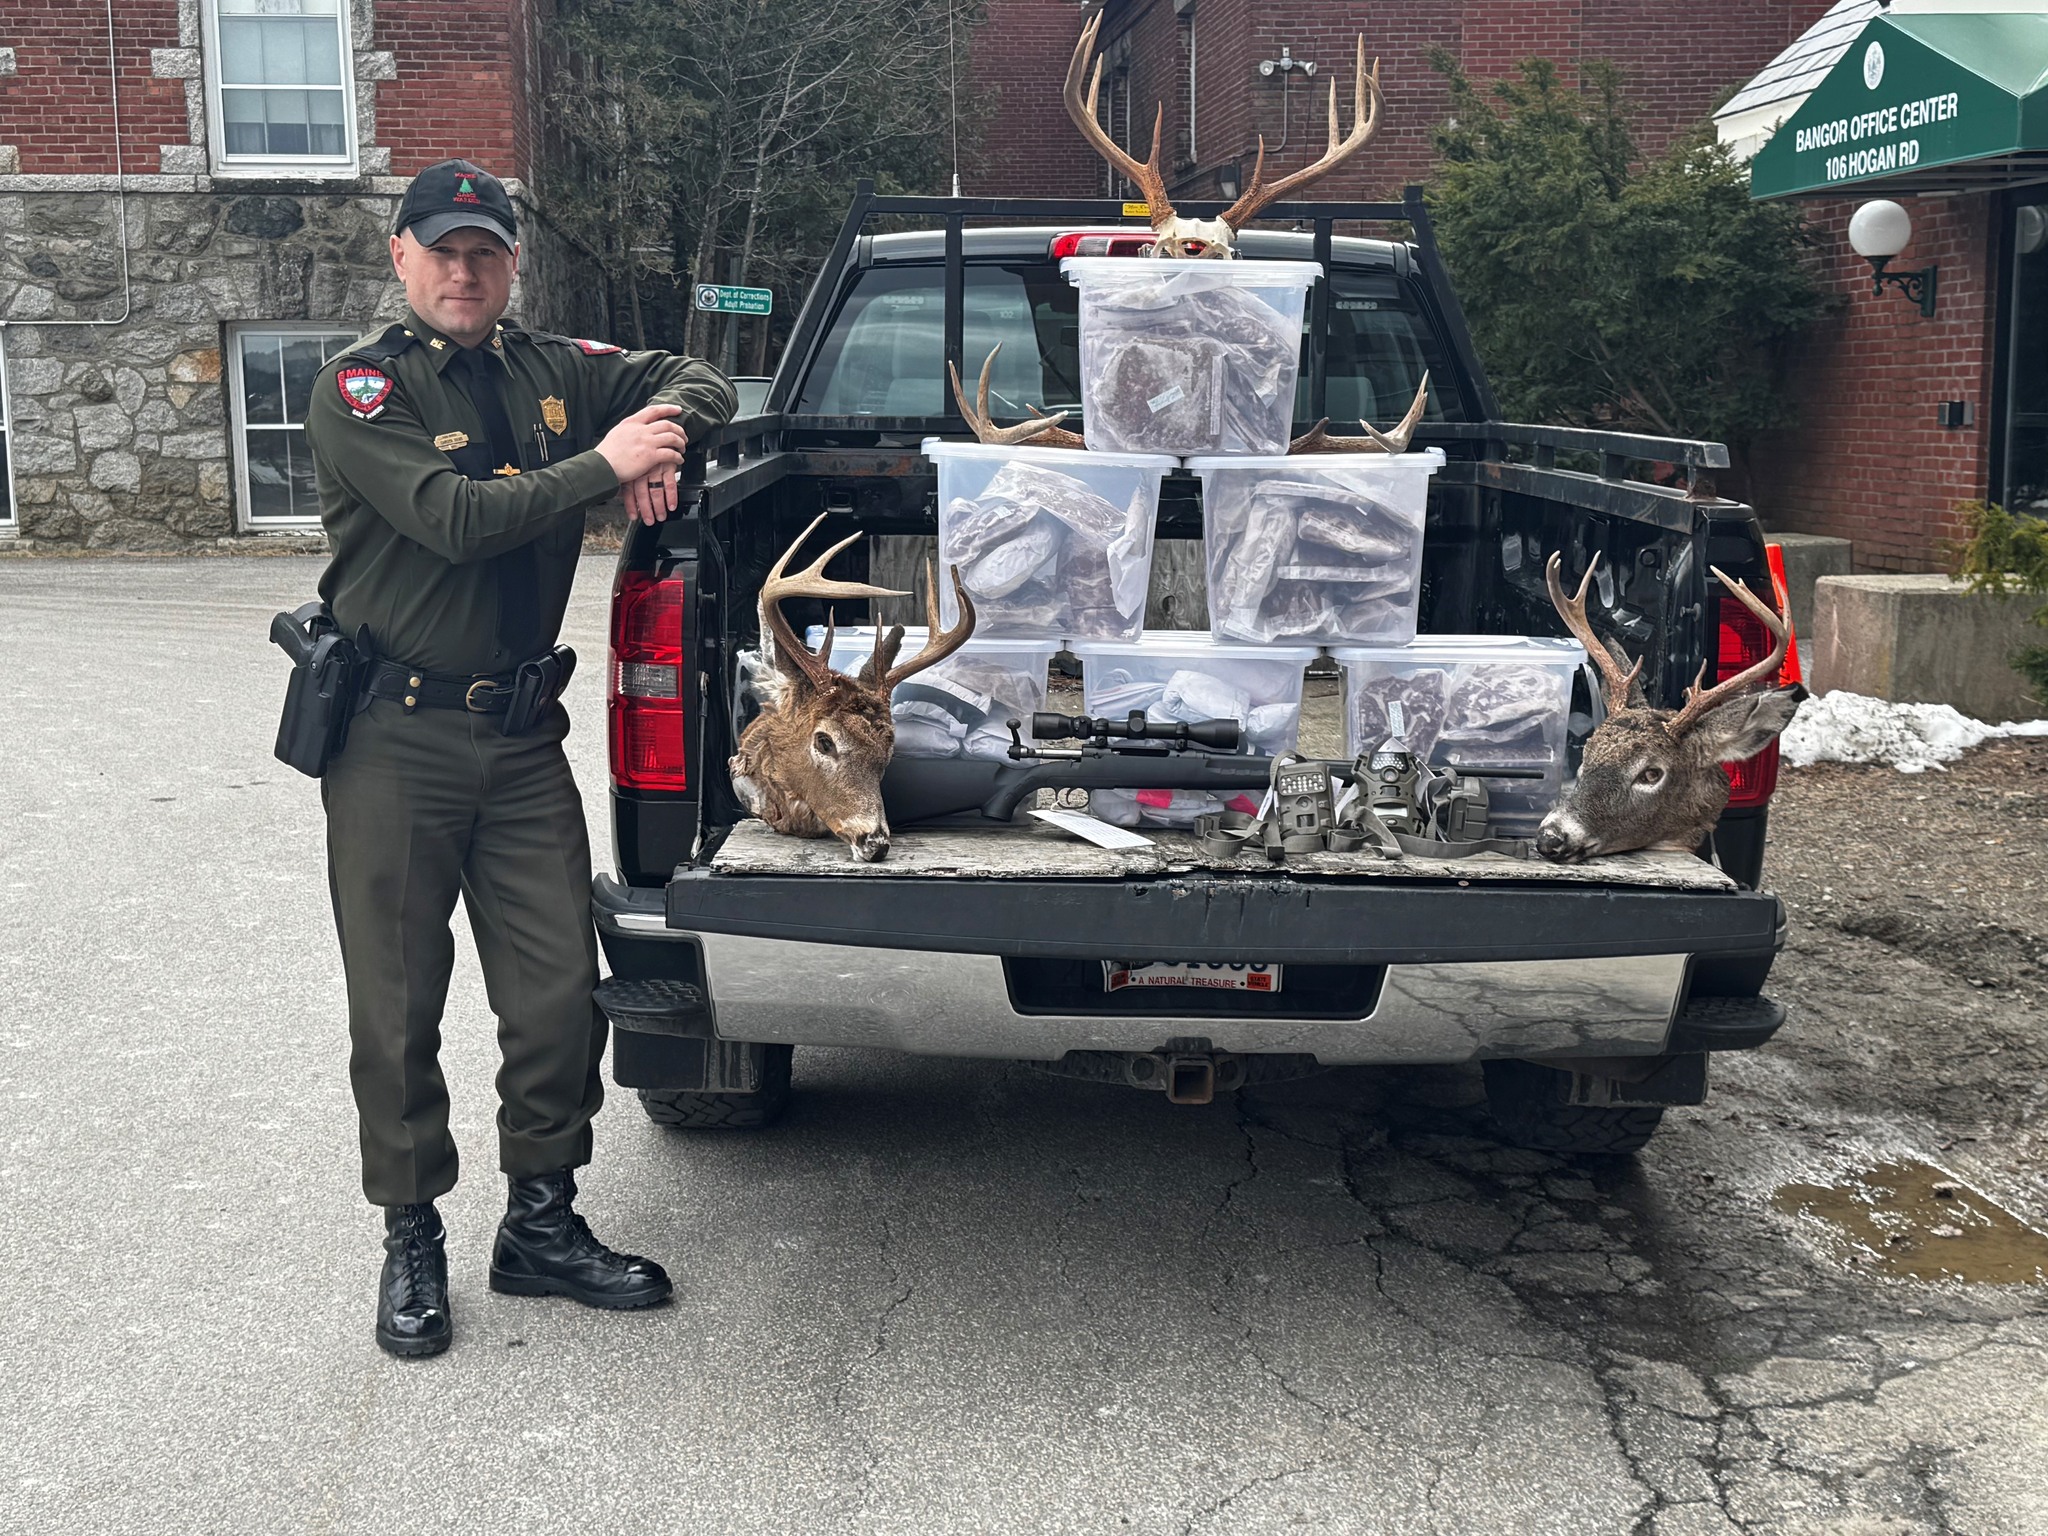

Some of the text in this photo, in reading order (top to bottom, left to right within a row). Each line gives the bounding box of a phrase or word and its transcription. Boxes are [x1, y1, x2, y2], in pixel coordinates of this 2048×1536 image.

[1795, 92, 1959, 153] BANGOR OFFICE CENTER
[1825, 139, 1920, 181] 106 HOGAN RD
[740, 291, 770, 301] Corrections
[724, 300, 765, 310] Adult Probation
[346, 368, 384, 378] MAINE
[1138, 976, 1145, 985] A
[1148, 976, 1187, 985] NATURAL
[1191, 977, 1237, 989] TREASURE
